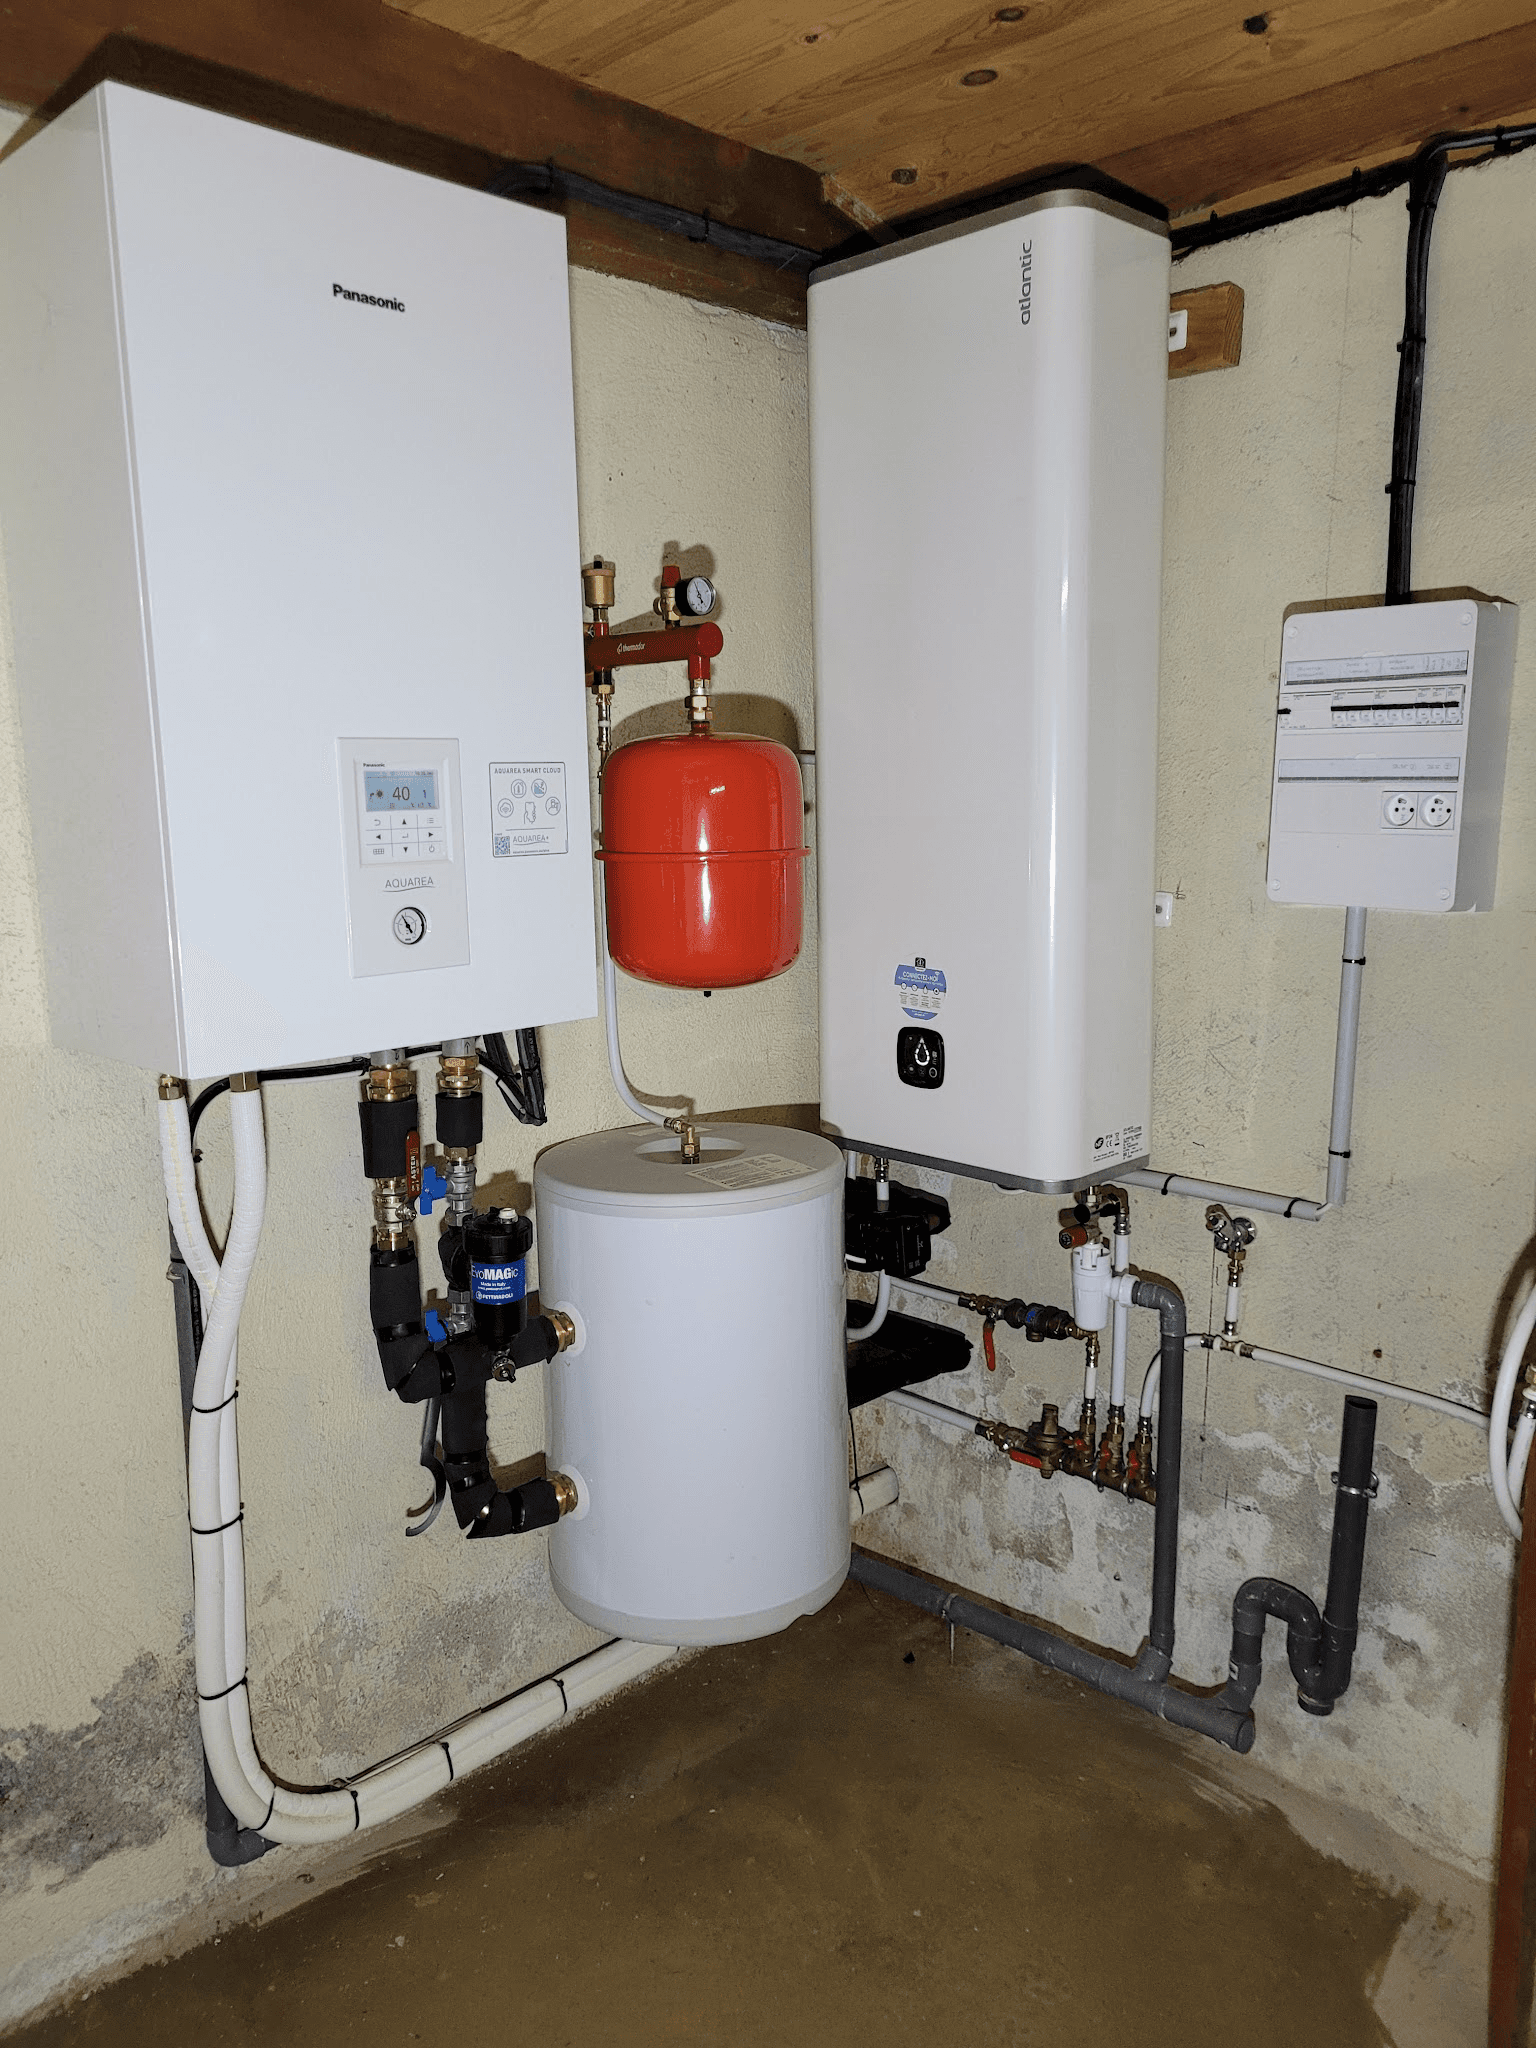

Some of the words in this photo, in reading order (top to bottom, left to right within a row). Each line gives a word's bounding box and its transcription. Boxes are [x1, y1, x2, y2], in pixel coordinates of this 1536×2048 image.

[1018, 239, 1033, 326] atlantic
[332, 283, 406, 313] Panasonic
[392, 786, 410, 801] 40
[384, 876, 434, 889] AQUAREA
